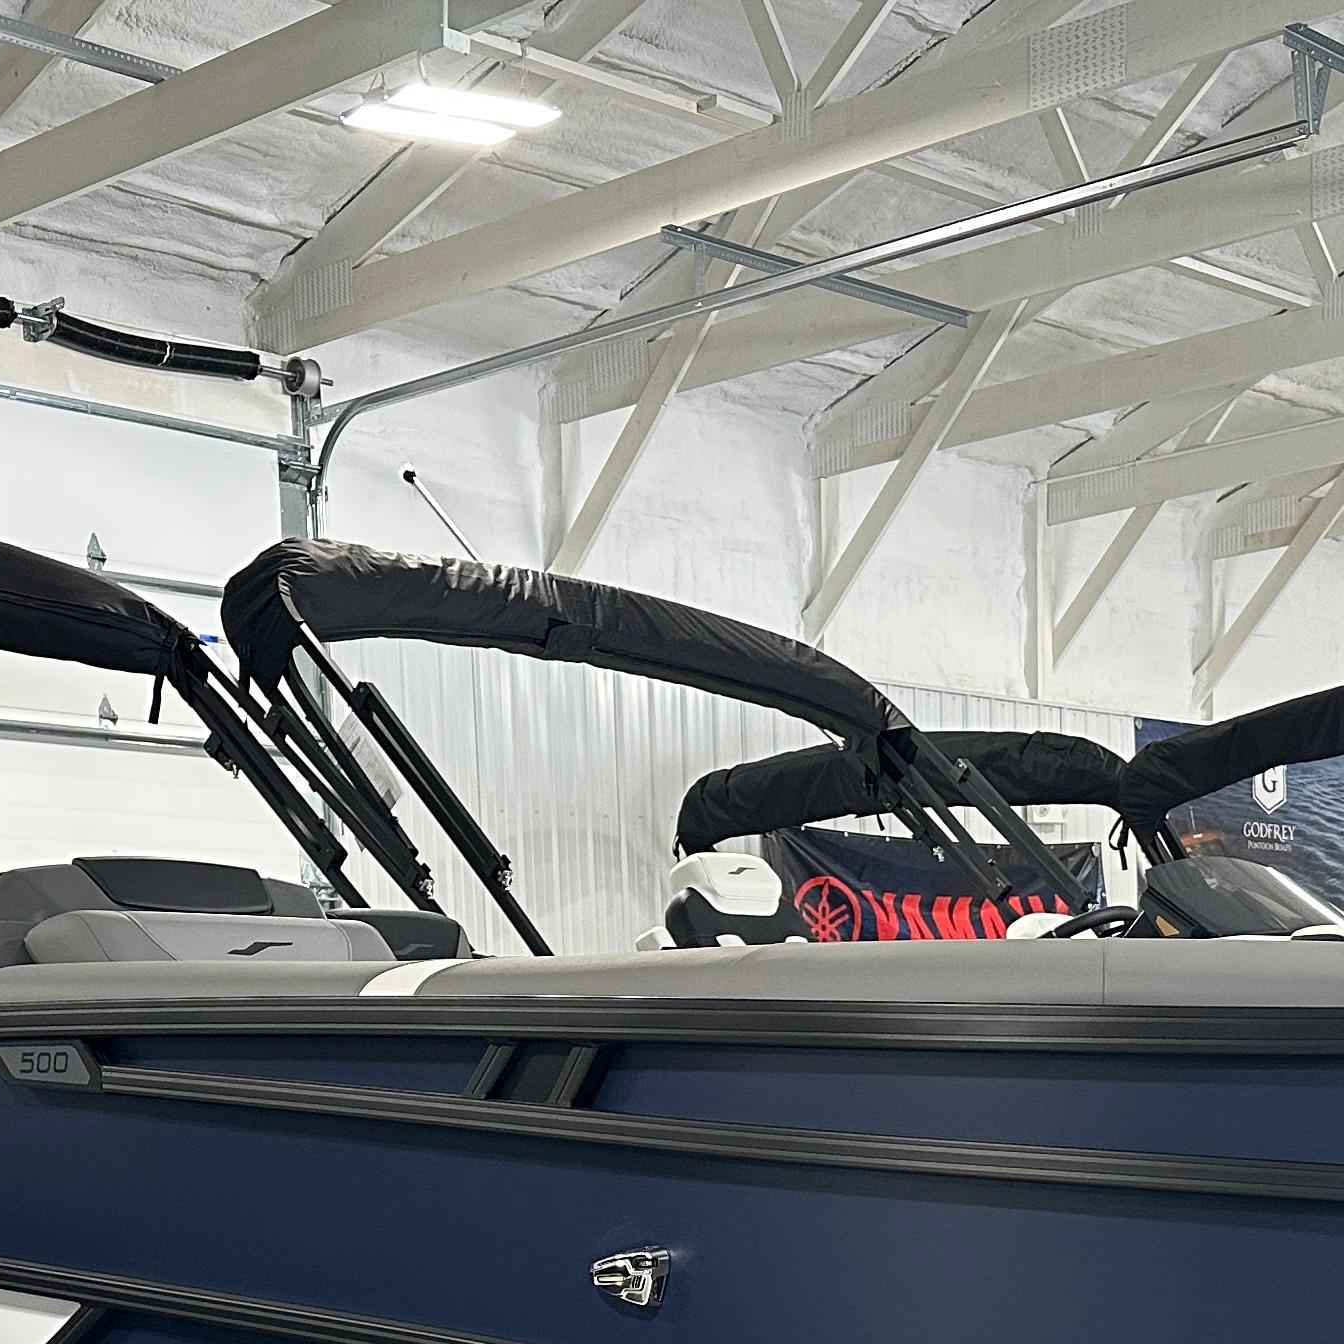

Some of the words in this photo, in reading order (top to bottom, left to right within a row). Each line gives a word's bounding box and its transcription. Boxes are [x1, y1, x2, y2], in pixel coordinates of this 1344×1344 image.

[1243, 821, 1296, 843] GODFREY
[861, 889, 1070, 940] YAMA
[19, 1051, 69, 1073] 500
